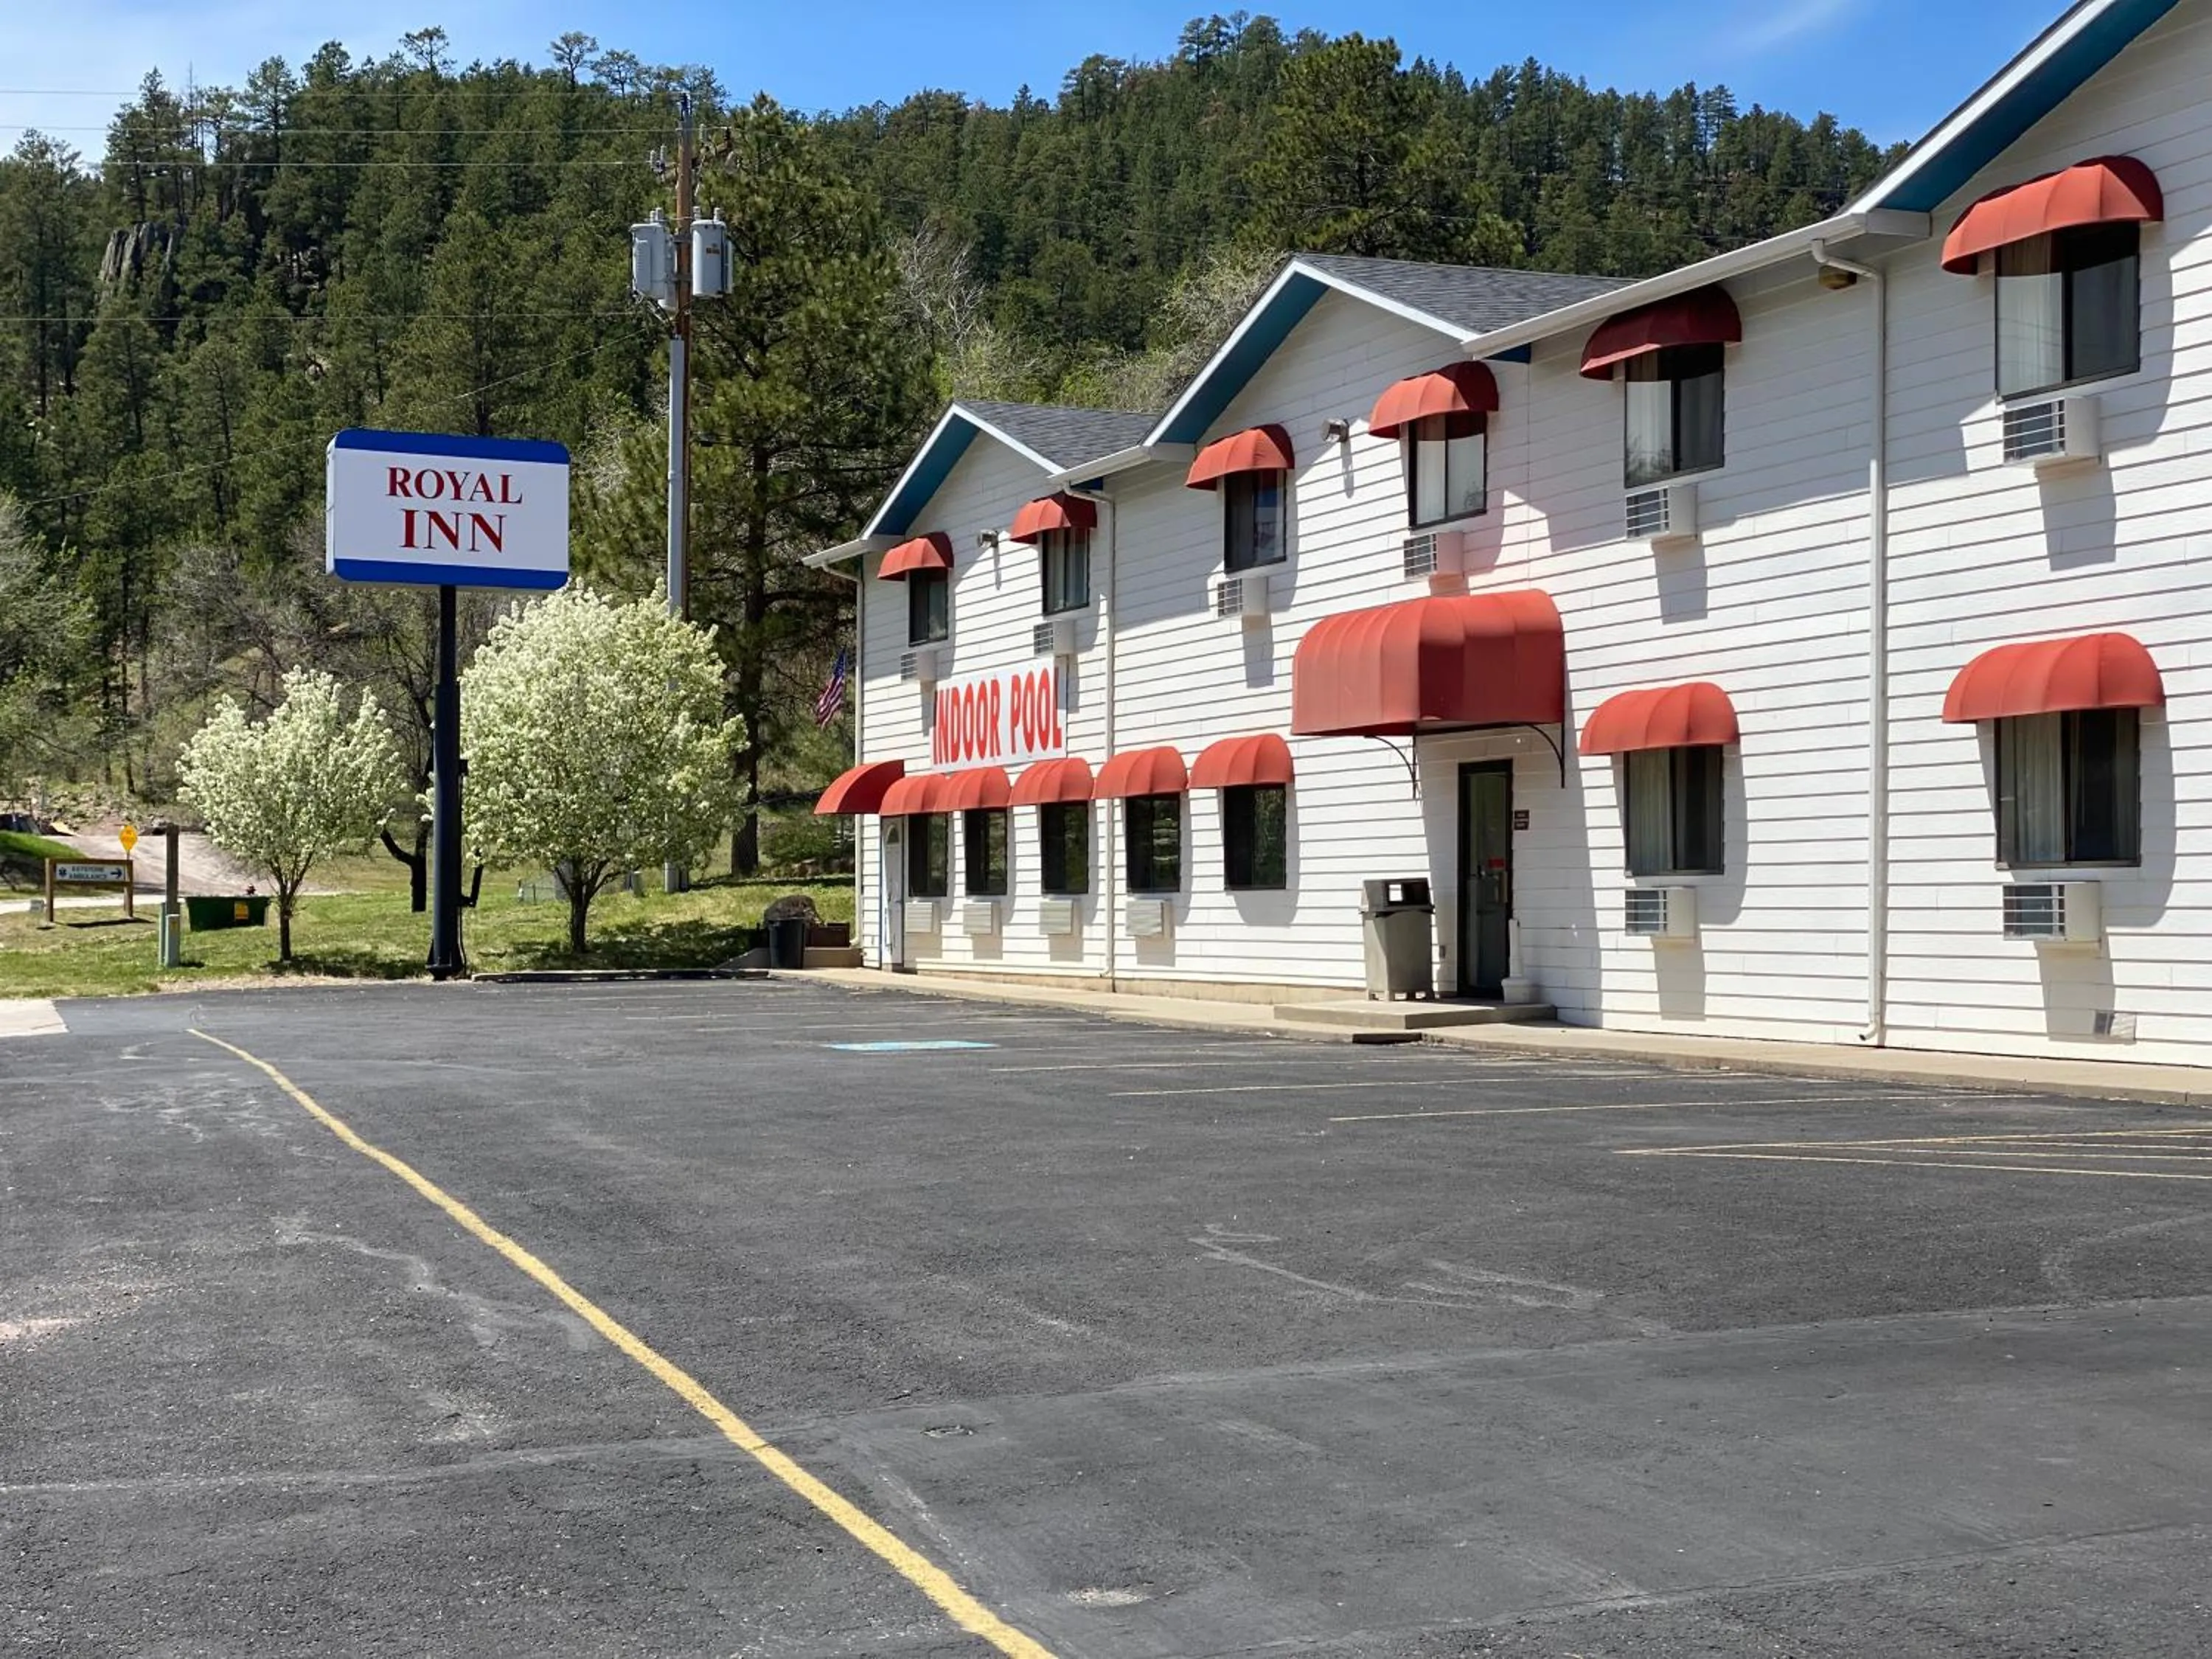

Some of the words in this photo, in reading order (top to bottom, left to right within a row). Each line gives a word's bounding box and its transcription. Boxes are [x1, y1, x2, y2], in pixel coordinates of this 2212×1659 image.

[386, 466, 523, 504] ROYAL
[400, 508, 507, 553] INN
[933, 678, 1001, 765] INDOOR
[1011, 667, 1062, 755] POOL
